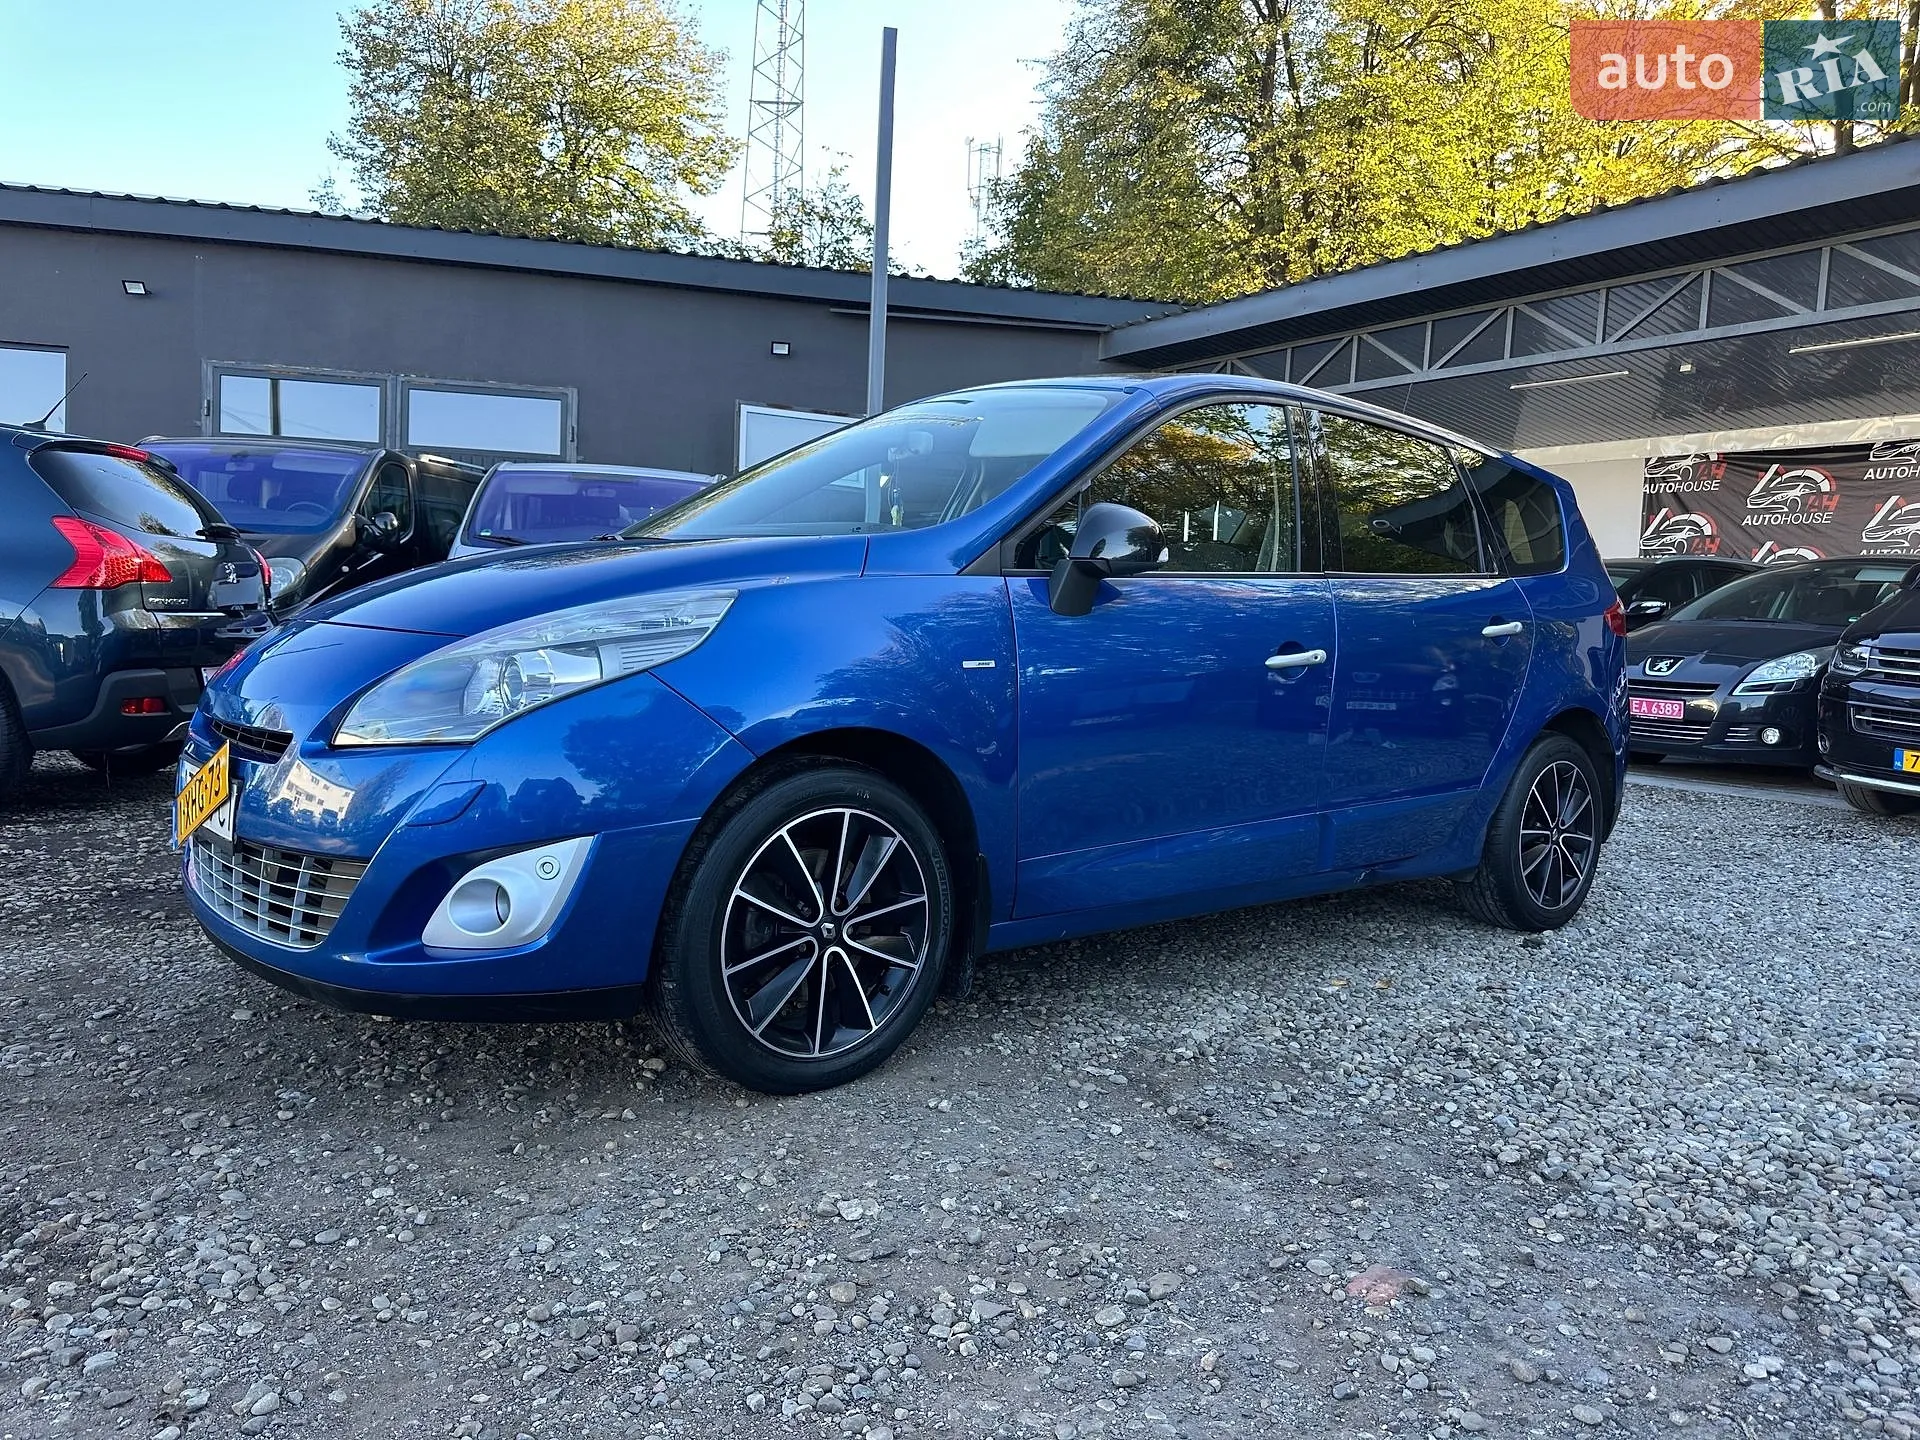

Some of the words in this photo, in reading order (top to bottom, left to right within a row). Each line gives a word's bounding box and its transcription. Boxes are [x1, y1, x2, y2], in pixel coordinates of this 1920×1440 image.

[1643, 480, 1720, 494] AUTOHOUSE
[1741, 512, 1833, 526] AUTOHOUSE
[1632, 700, 1648, 713] EA
[1651, 702, 1680, 716] 6389
